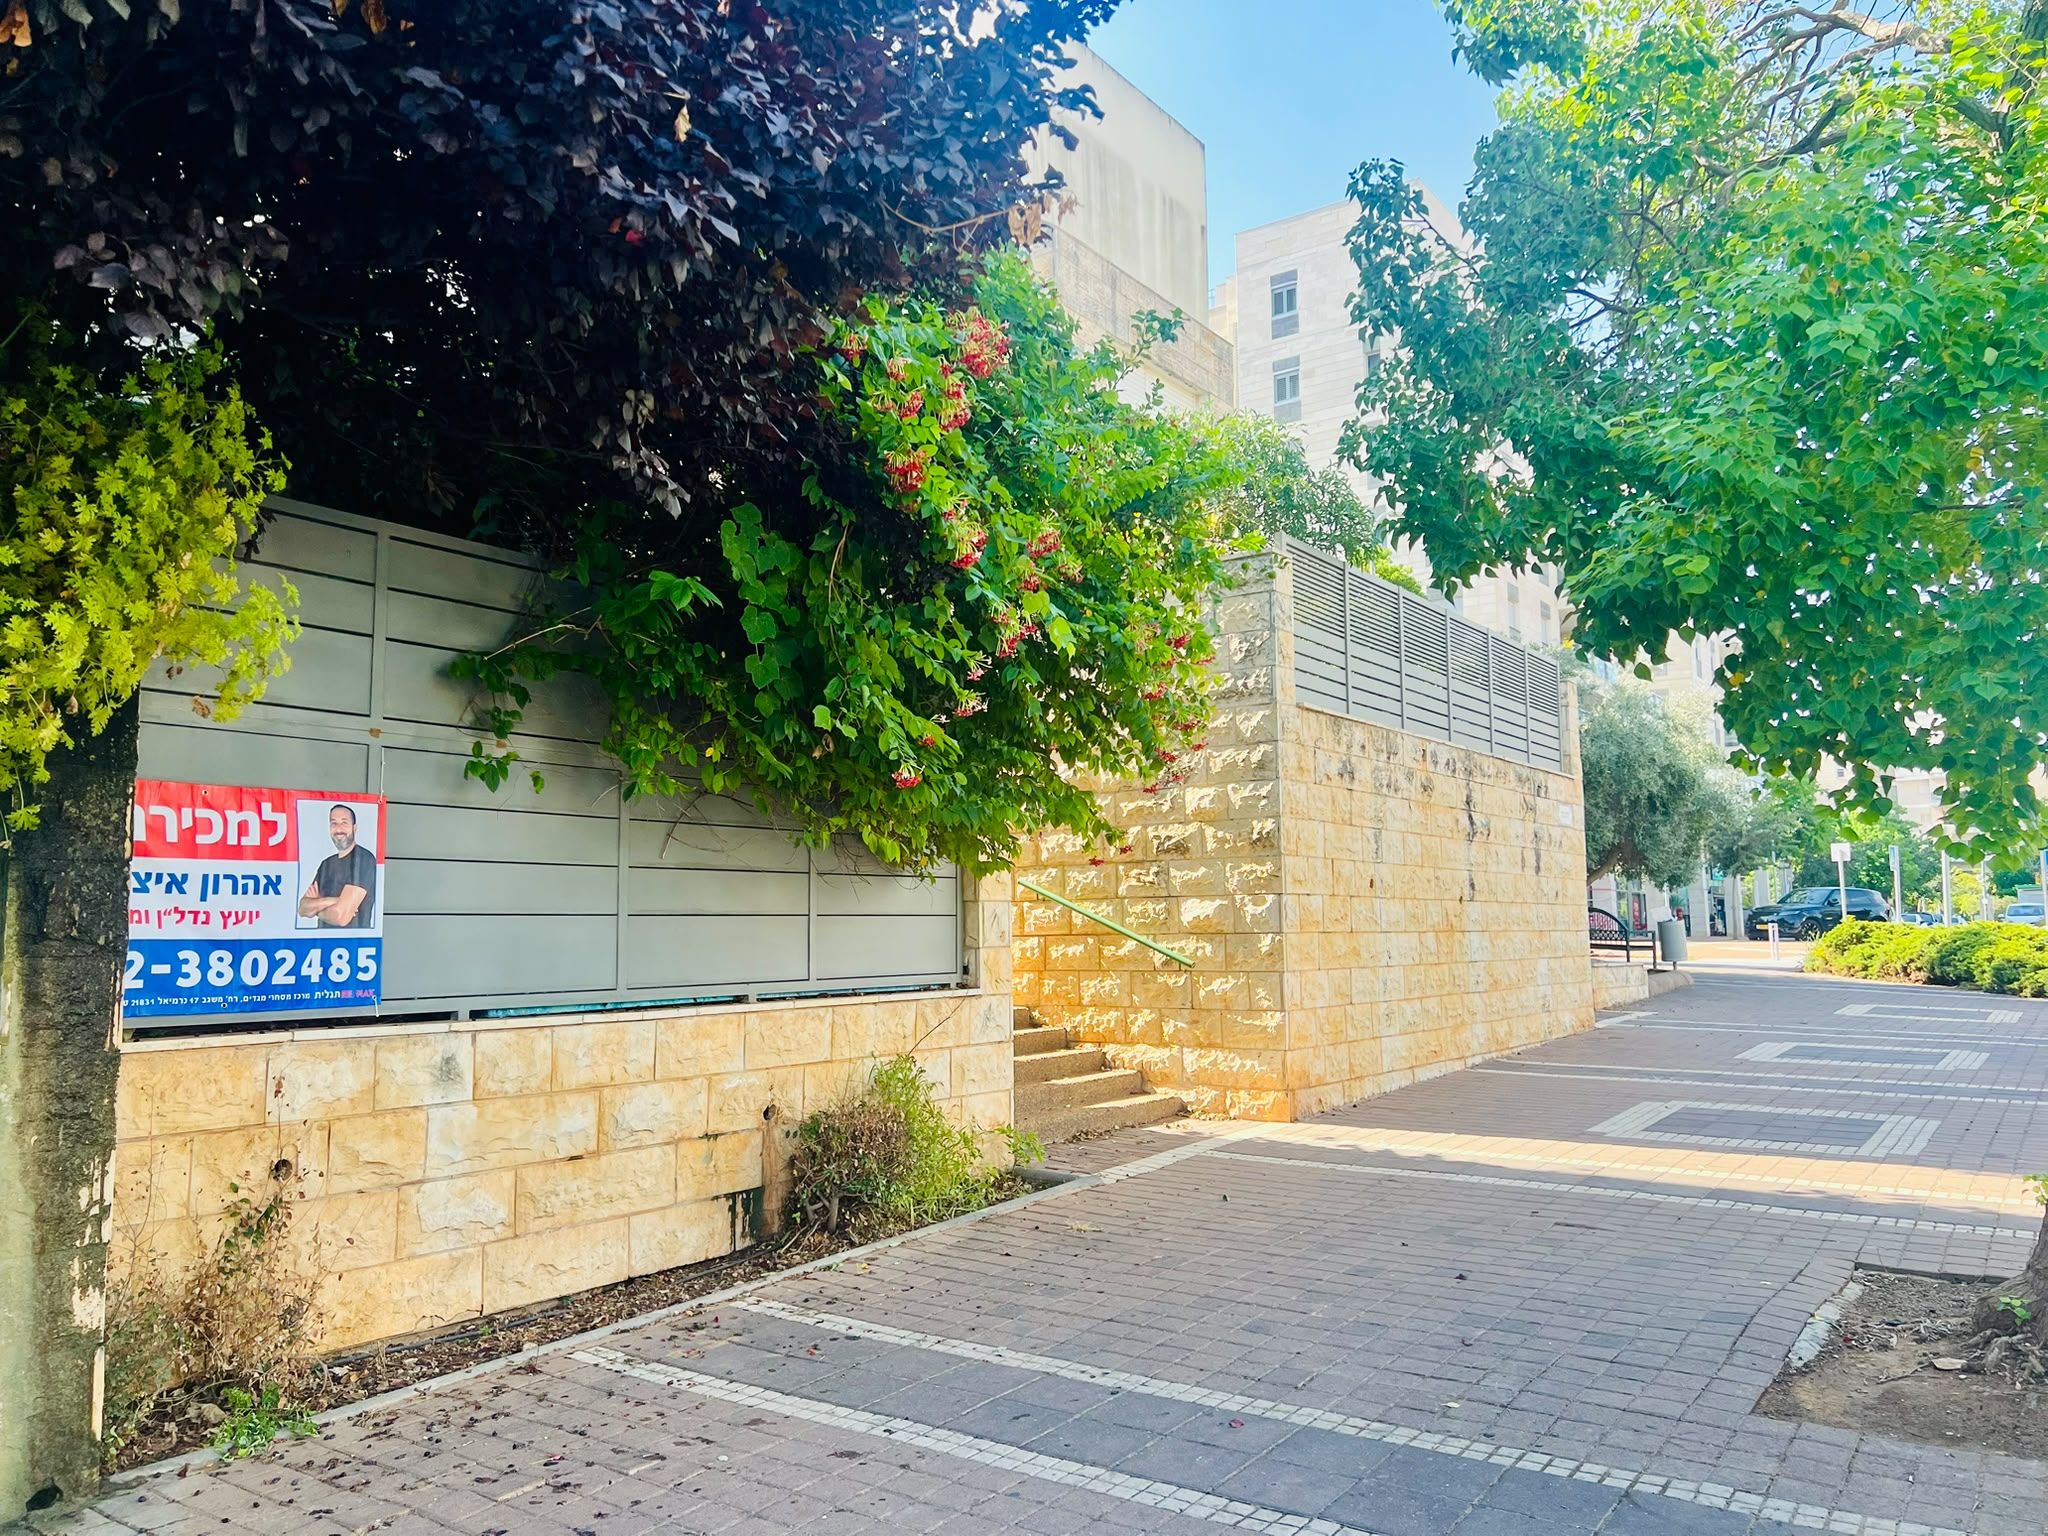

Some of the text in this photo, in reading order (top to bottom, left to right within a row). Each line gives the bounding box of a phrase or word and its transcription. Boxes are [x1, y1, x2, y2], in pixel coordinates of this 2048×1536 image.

[199, 873, 282, 903] אהרון
[219, 910, 261, 930] יועץ
[122, 946, 378, 990] 2-3802485
[267, 993, 292, 1001] מסחרי
[292, 992, 311, 1000] מרכז
